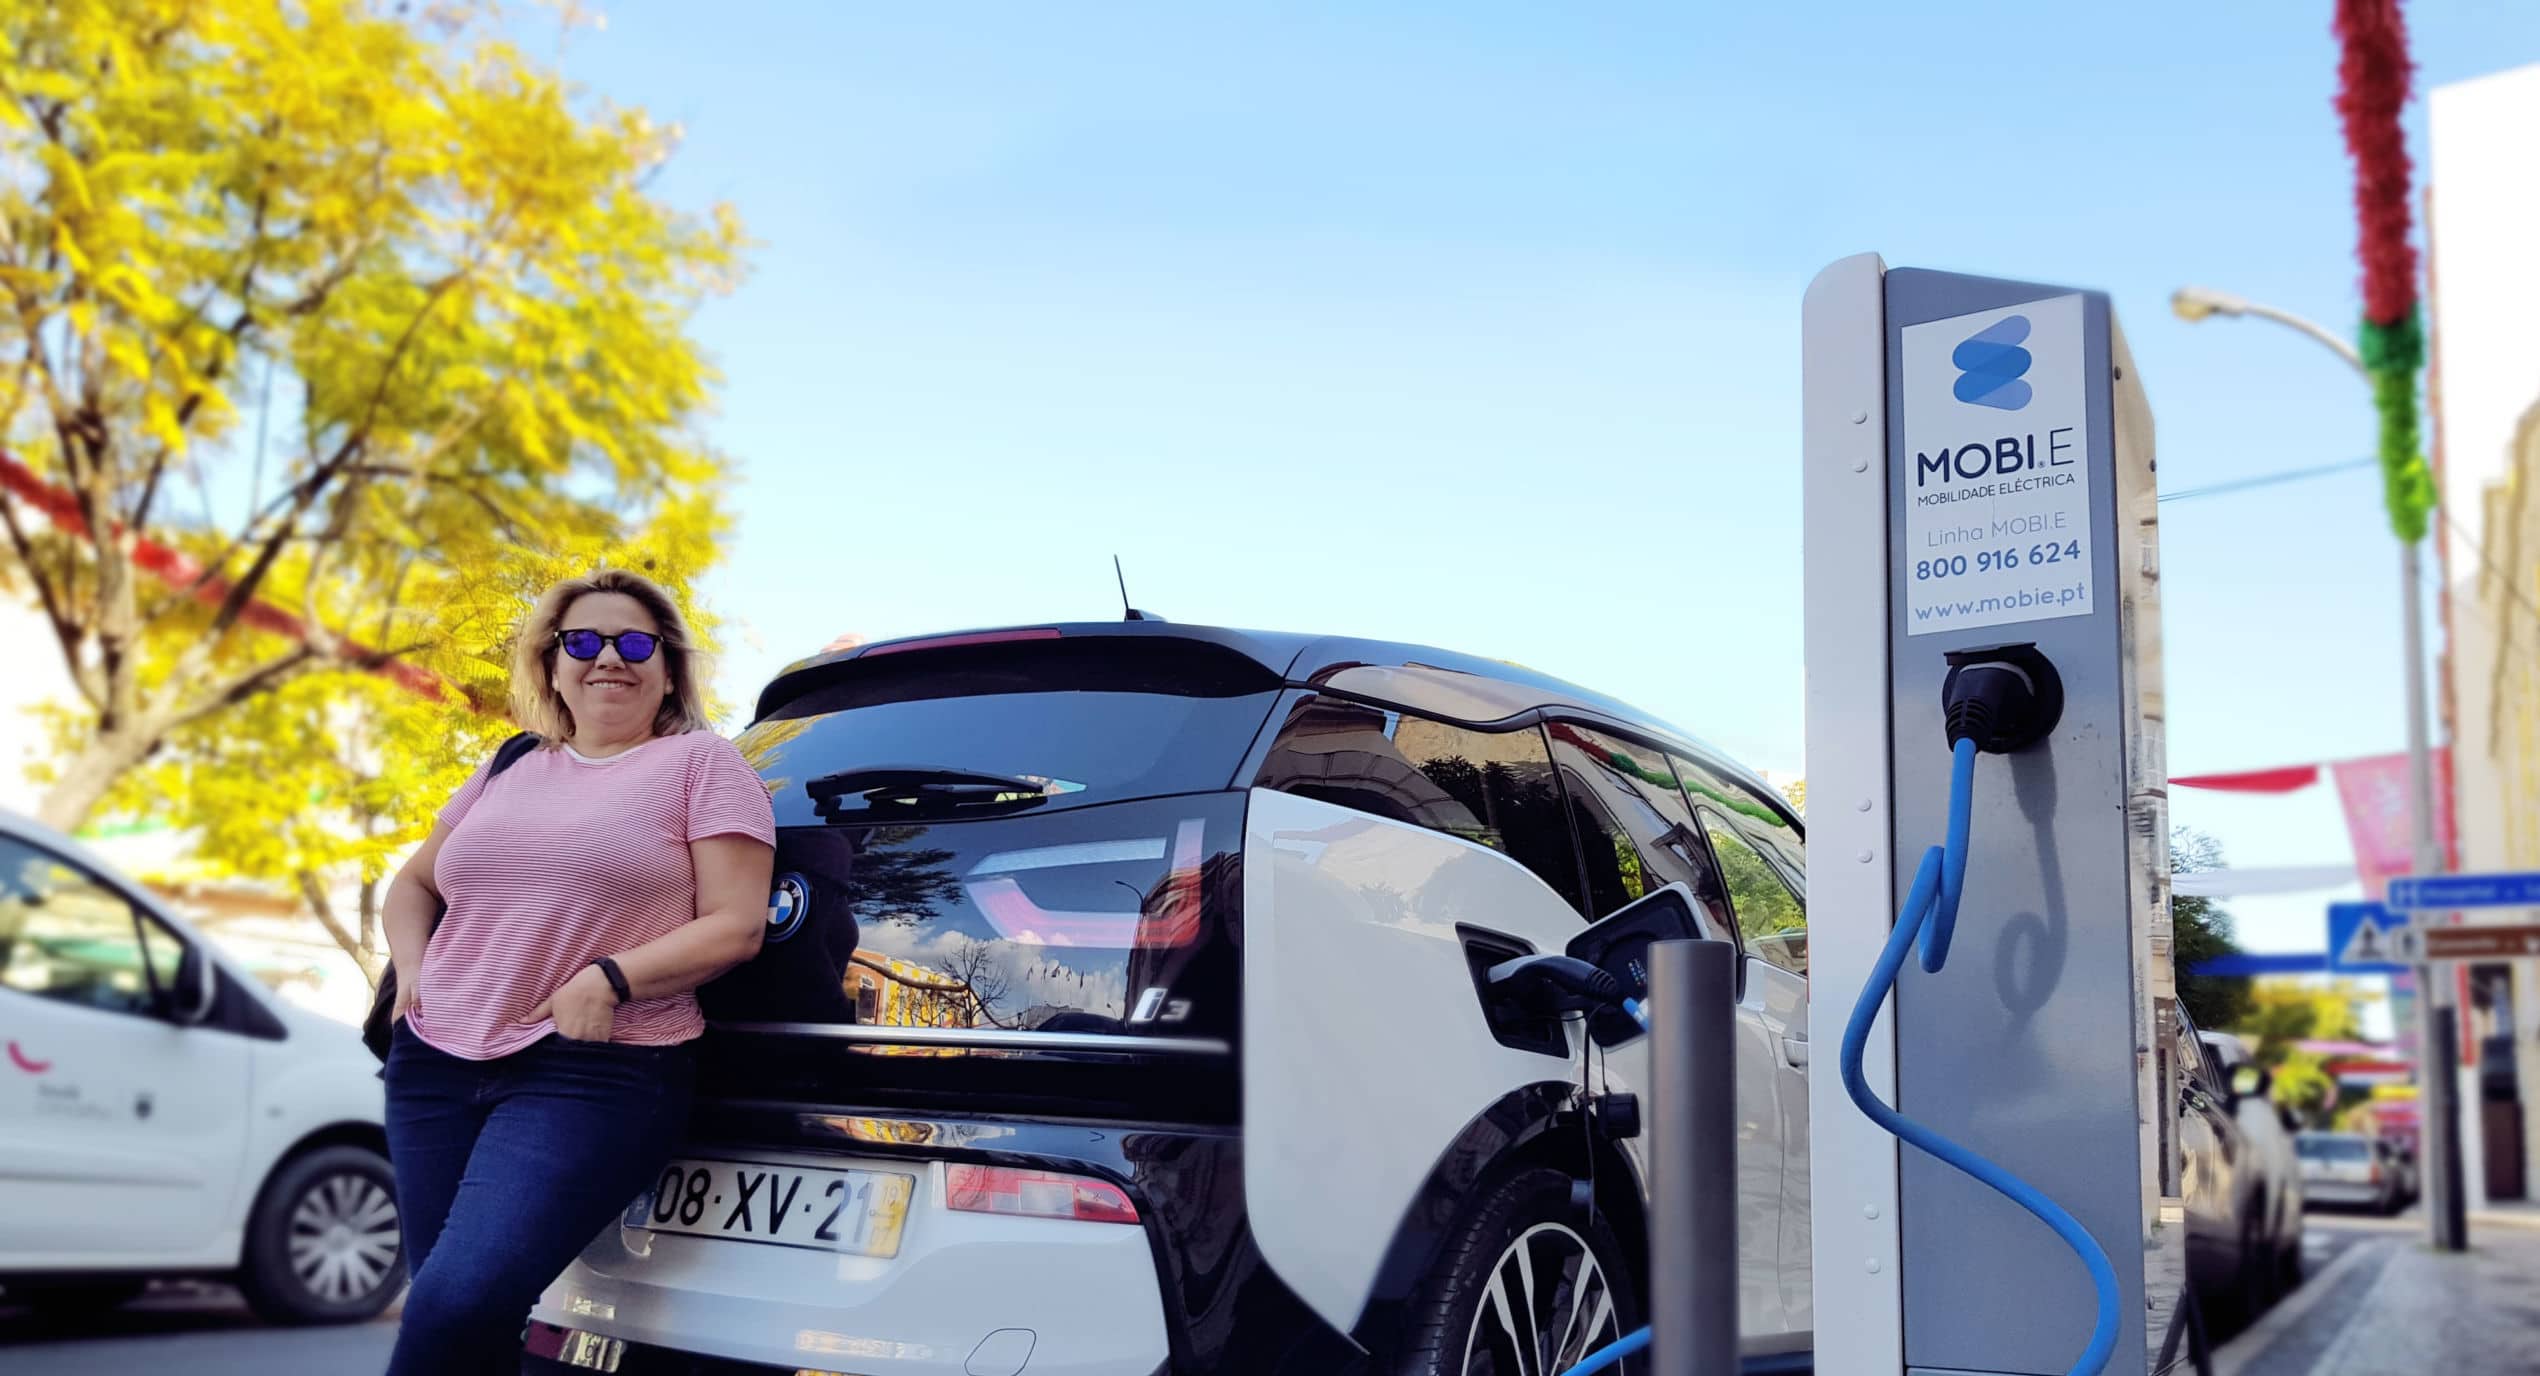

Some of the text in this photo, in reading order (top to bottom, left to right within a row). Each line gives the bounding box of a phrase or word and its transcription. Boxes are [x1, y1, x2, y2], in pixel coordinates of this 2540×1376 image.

[1917, 473, 2075, 507] MOBILIDADE ELÉCTRICA
[1927, 526, 1984, 548] Linha
[1916, 539, 2081, 580] 800 916 624
[1915, 582, 2086, 620] www.mobie.pt
[1130, 987, 1192, 1022] i3
